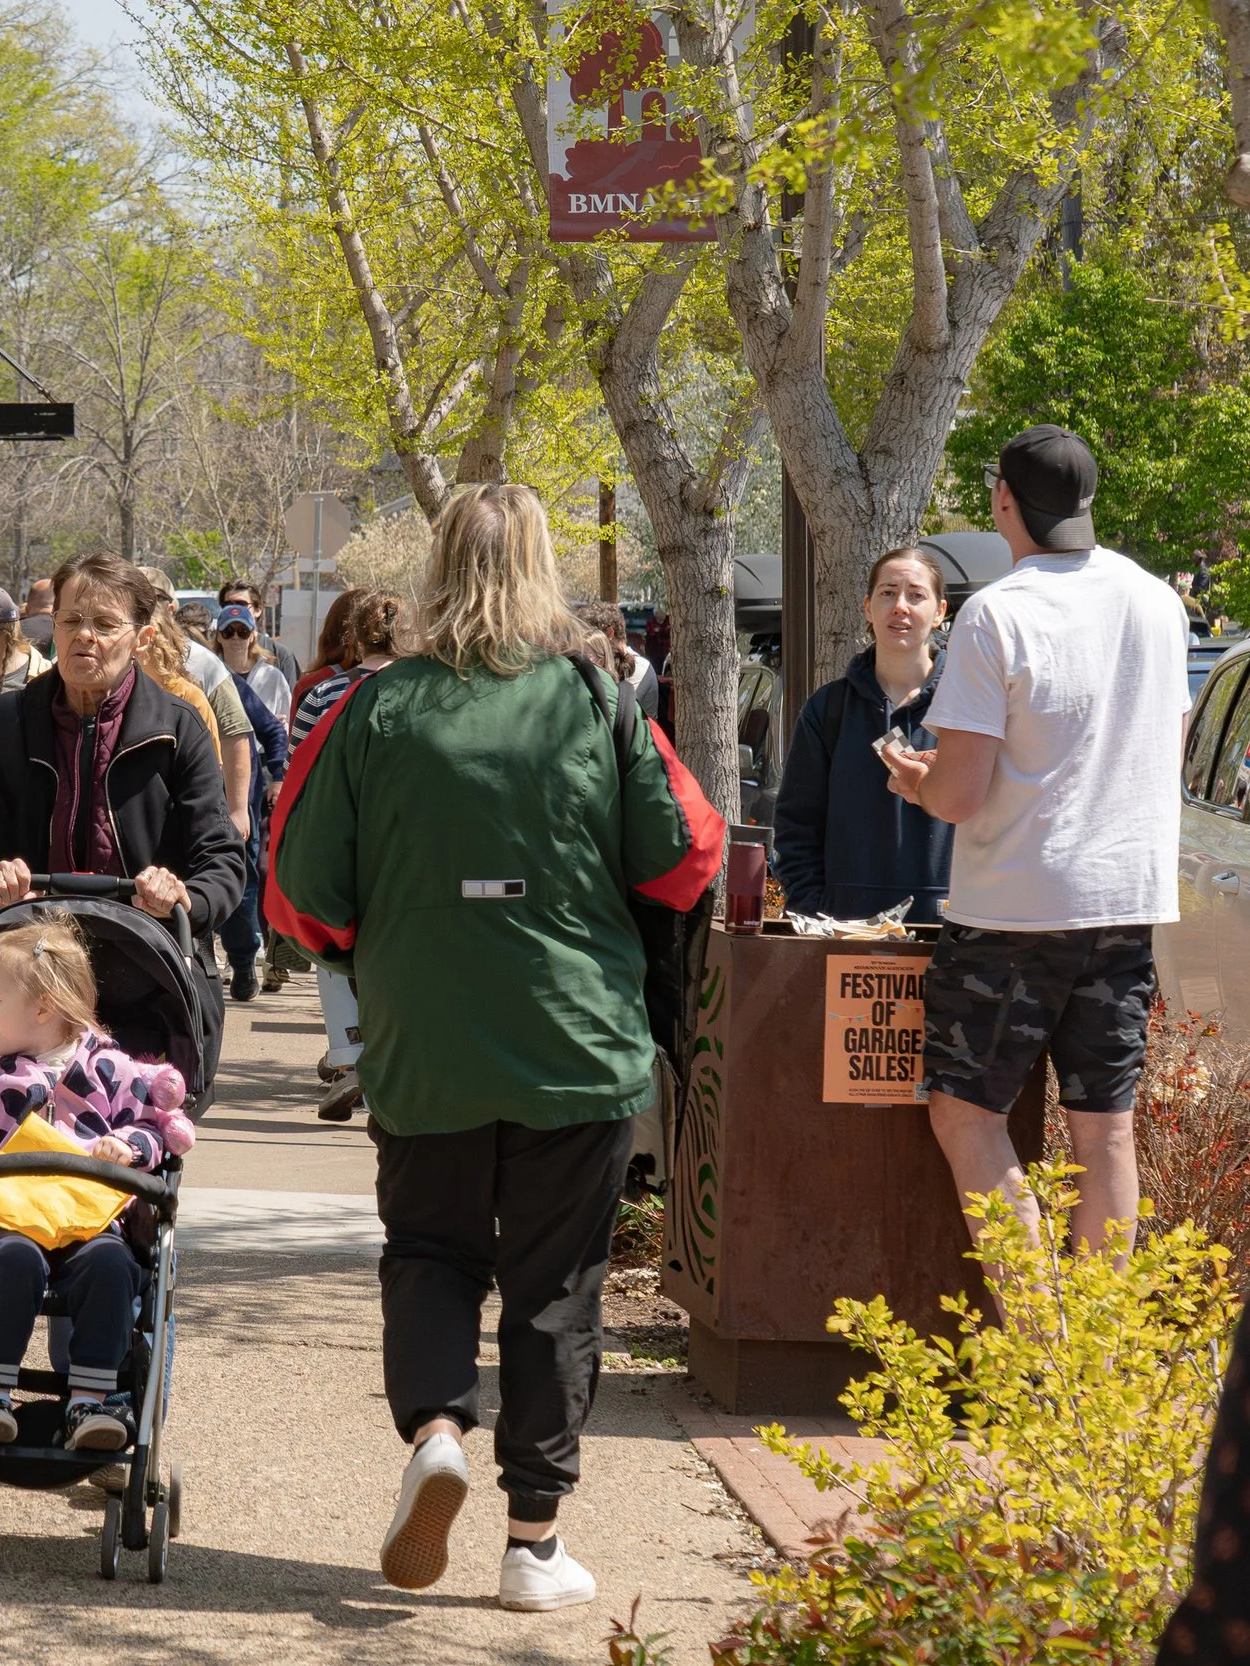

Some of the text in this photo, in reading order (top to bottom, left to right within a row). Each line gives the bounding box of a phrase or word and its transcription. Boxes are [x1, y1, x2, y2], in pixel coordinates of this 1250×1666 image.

[871, 1000, 896, 1026] OF
[844, 1028, 922, 1054] GARAGE
[848, 1055, 915, 1082] SALES!
